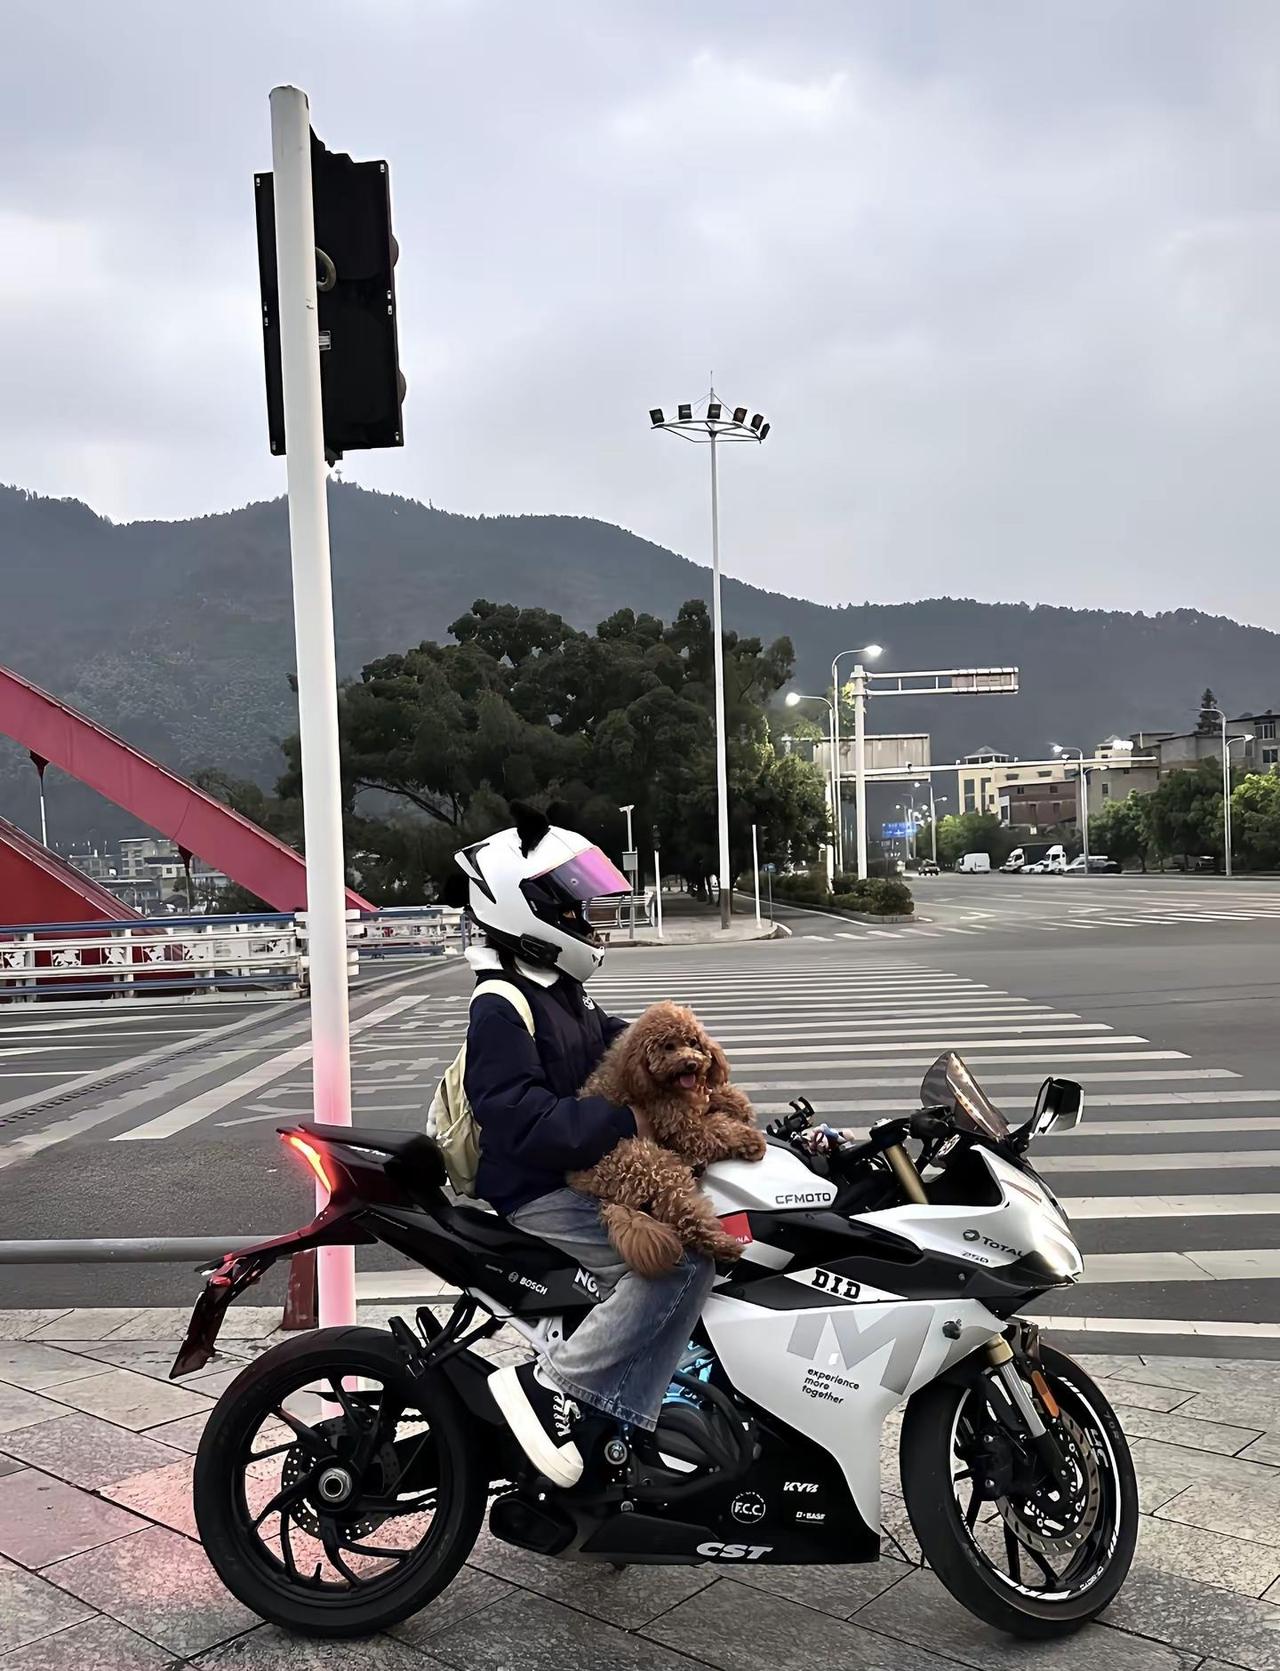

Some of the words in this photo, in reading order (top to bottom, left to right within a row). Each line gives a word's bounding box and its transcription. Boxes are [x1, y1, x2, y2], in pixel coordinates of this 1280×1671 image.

[775, 1192, 831, 1205] CFMOTO
[982, 1236, 1024, 1258] TOTAL
[519, 1276, 548, 1296] BOSCH
[574, 1267, 600, 1298] NG
[811, 1268, 861, 1300] D.I.D
[804, 1377, 830, 1390] more
[807, 1368, 860, 1390] experience
[801, 1385, 844, 1404] together
[696, 1542, 774, 1560] CST
